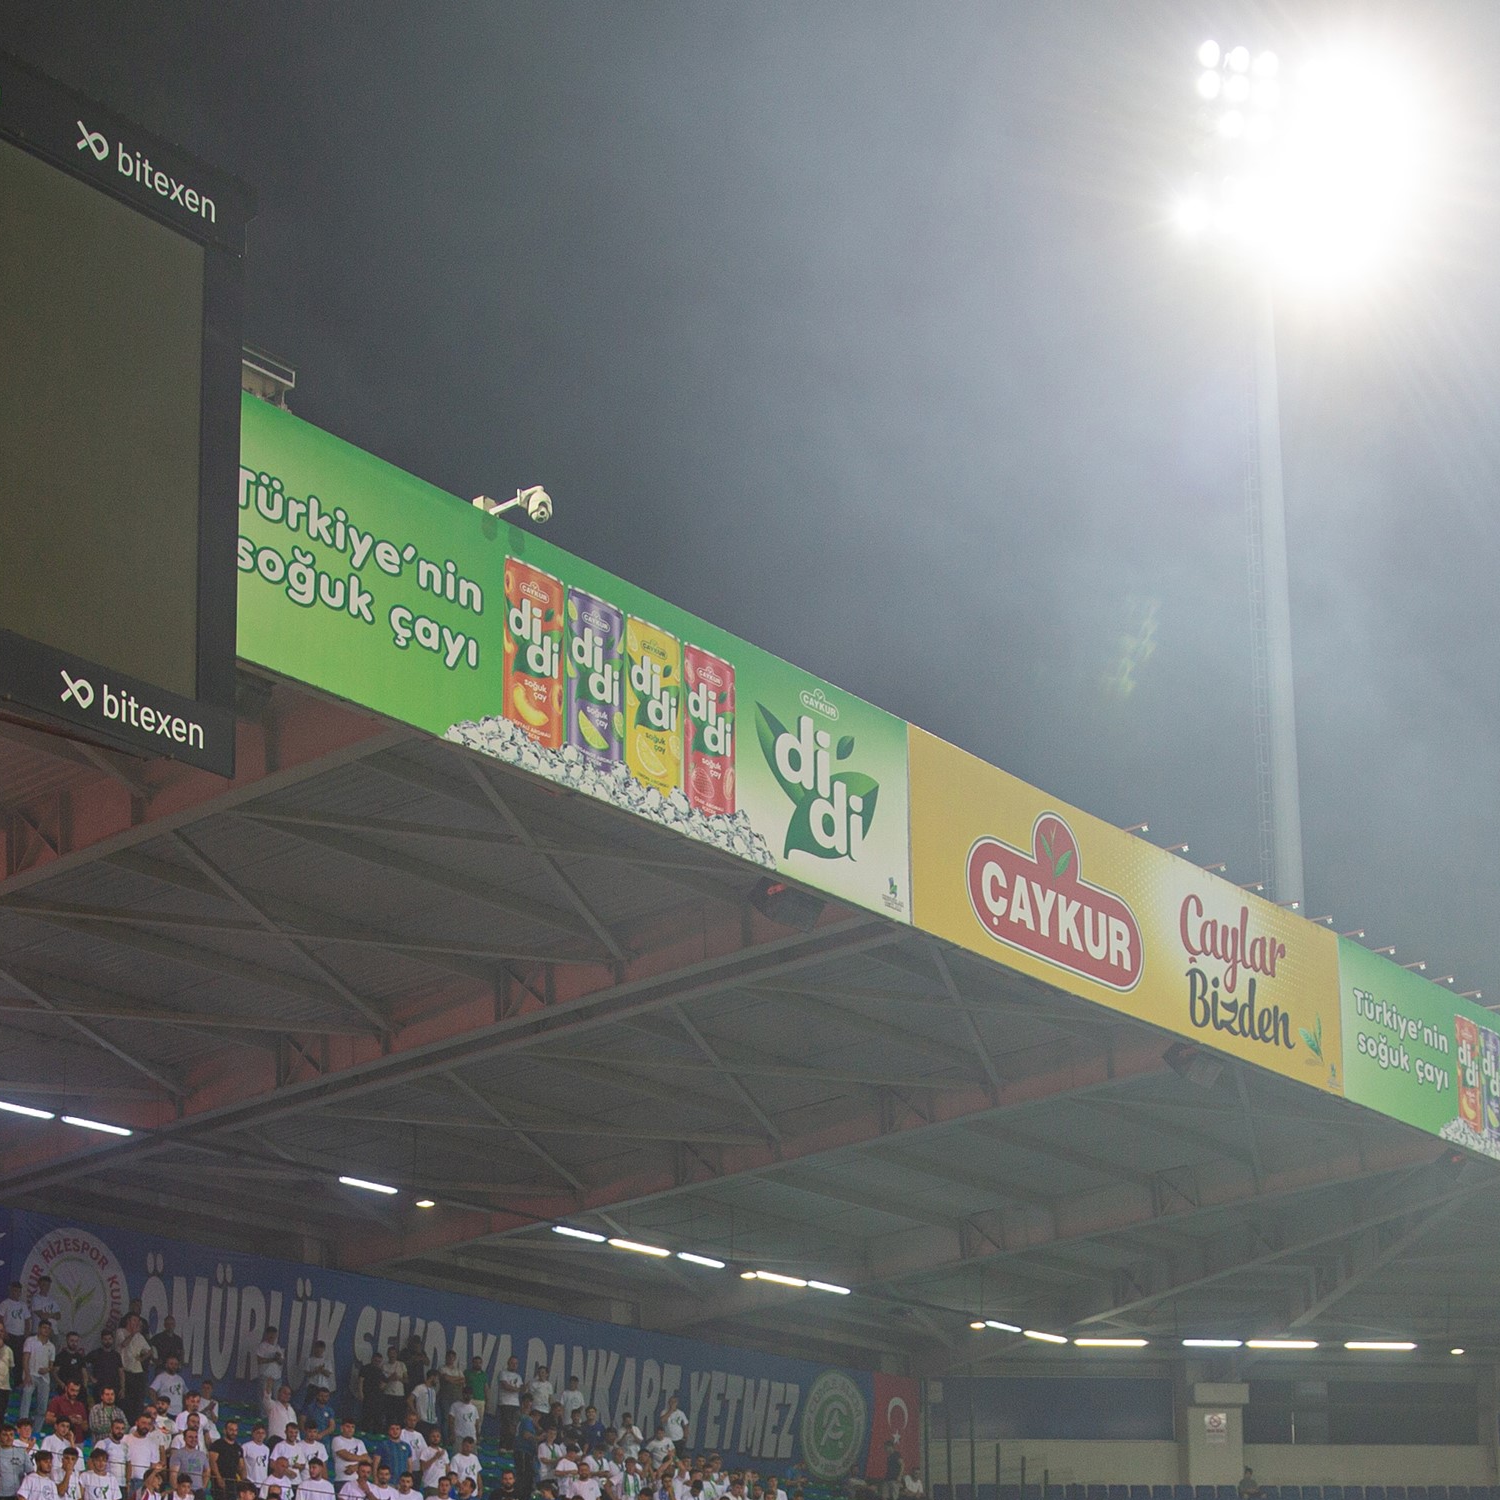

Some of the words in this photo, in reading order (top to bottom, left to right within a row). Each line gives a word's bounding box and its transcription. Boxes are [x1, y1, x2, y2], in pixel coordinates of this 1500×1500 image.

[117, 142, 216, 223] bitexen
[237, 537, 374, 623] soğuk
[390, 606, 478, 668] çayı
[509, 598, 542, 645] di
[527, 635, 559, 679] di
[572, 627, 603, 673] di
[589, 664, 619, 706] di
[631, 655, 661, 701] di
[102, 685, 205, 750] bitexen
[647, 690, 677, 732] di
[688, 682, 716, 726] di
[802, 694, 839, 720] ÇAYKUR
[703, 718, 732, 757] di
[775, 715, 831, 799] di
[809, 780, 863, 855] di
[982, 861, 1132, 972] ÇAYKUR
[1180, 894, 1286, 993] Çaylar
[1186, 967, 1296, 1049] Bizden
[1353, 988, 1449, 1054] Türkiye'nin
[1358, 1032, 1410, 1072] soğuk
[1416, 1058, 1448, 1092] çayı
[1458, 1040, 1471, 1067] di
[1466, 1060, 1479, 1087] di
[1482, 1051, 1495, 1079] di
[41, 1236, 109, 1271] RİZESPOR
[685, 1370, 799, 1460] YETMEZ
